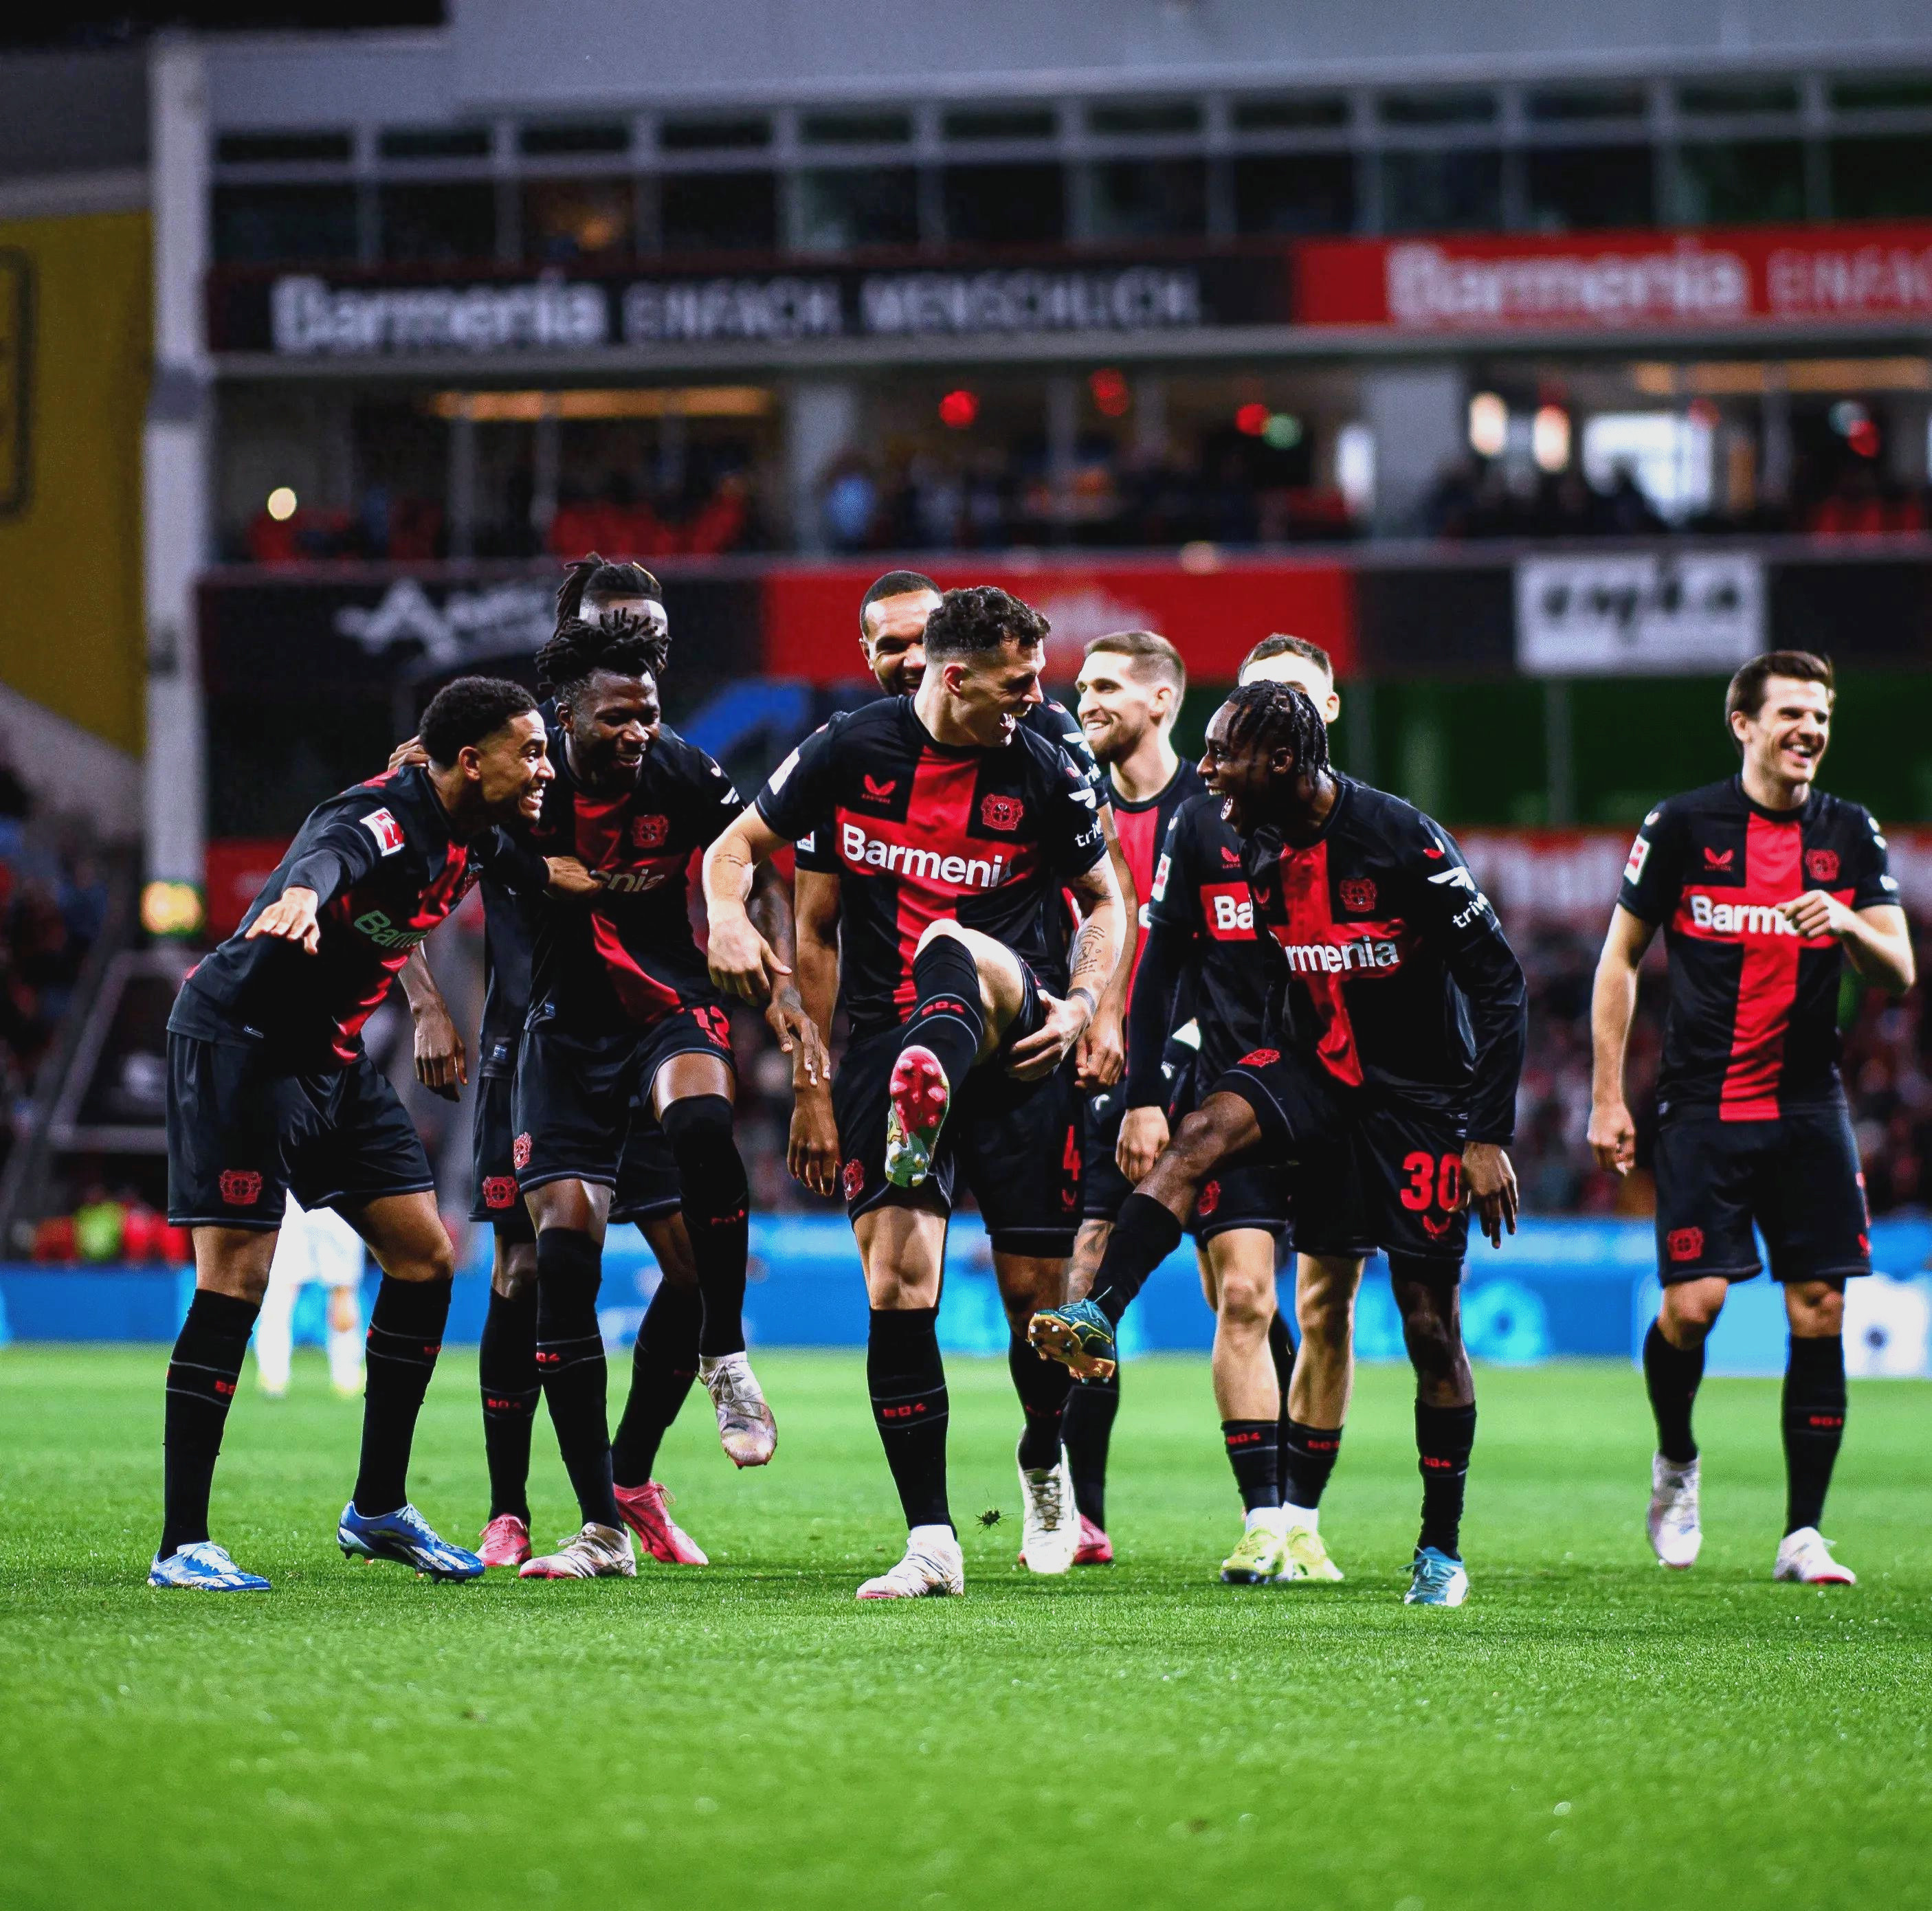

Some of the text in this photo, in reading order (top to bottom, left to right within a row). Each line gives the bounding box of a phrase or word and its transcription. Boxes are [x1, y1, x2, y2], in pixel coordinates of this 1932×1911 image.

[1766, 249, 1932, 306] EINFA
[271, 272, 608, 352] Barmenia
[1283, 935, 1400, 973] rmenia
[1062, 1125, 1082, 1182] 4
[1400, 1151, 1462, 1211] 30
